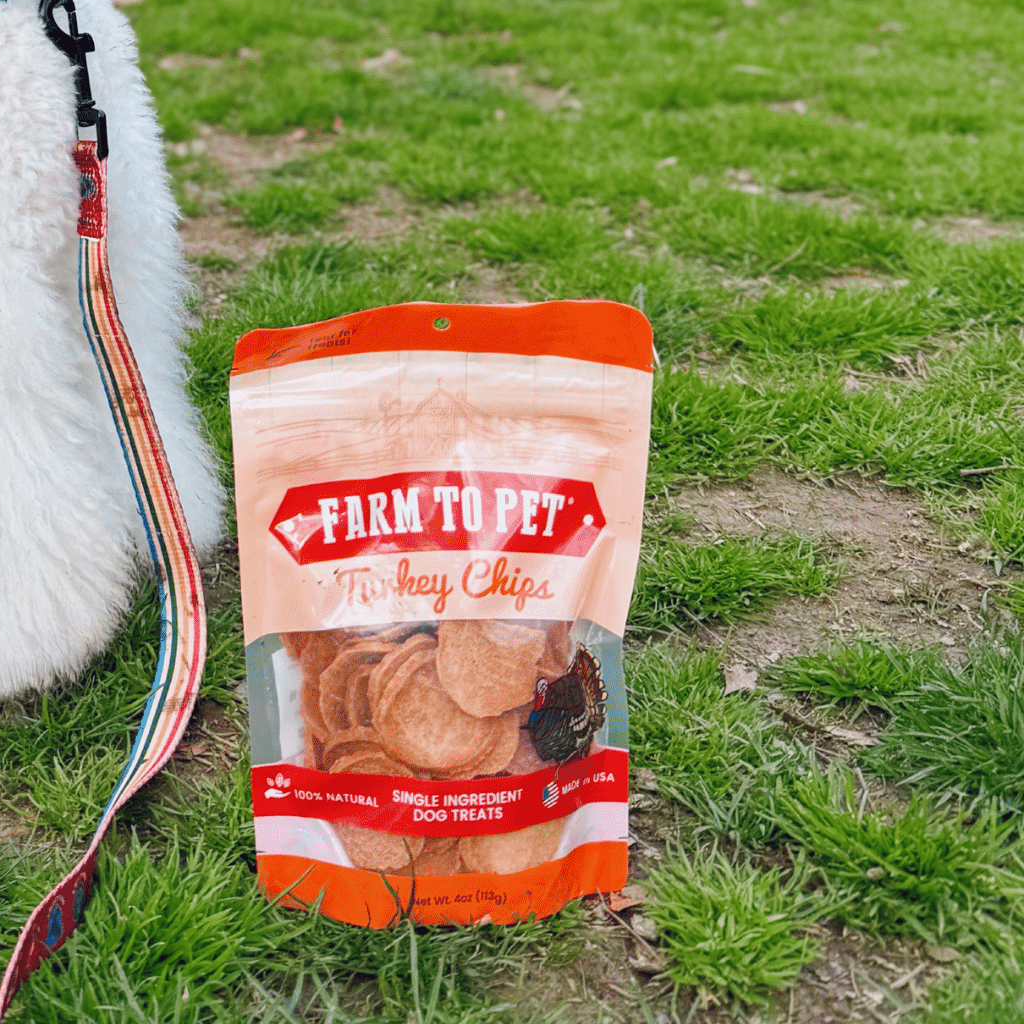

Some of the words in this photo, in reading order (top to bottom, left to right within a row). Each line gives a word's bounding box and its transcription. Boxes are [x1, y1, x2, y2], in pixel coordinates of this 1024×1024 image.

[318, 486, 424, 545] FARM
[433, 485, 483, 532] TO
[336, 557, 454, 614] Turkey
[461, 556, 555, 612] Chips
[561, 778, 581, 795] MADE
[582, 776, 591, 786] IN
[592, 771, 616, 783] USA
[293, 789, 323, 801] 100%
[326, 792, 380, 808] NATURAL
[392, 789, 440, 808] SINGLE
[443, 788, 524, 807] INGREDIENT
[413, 808, 448, 822] DOG
[452, 807, 504, 822] TREATS
[454, 893, 473, 904] 4oz
[475, 889, 507, 906] (113g)
